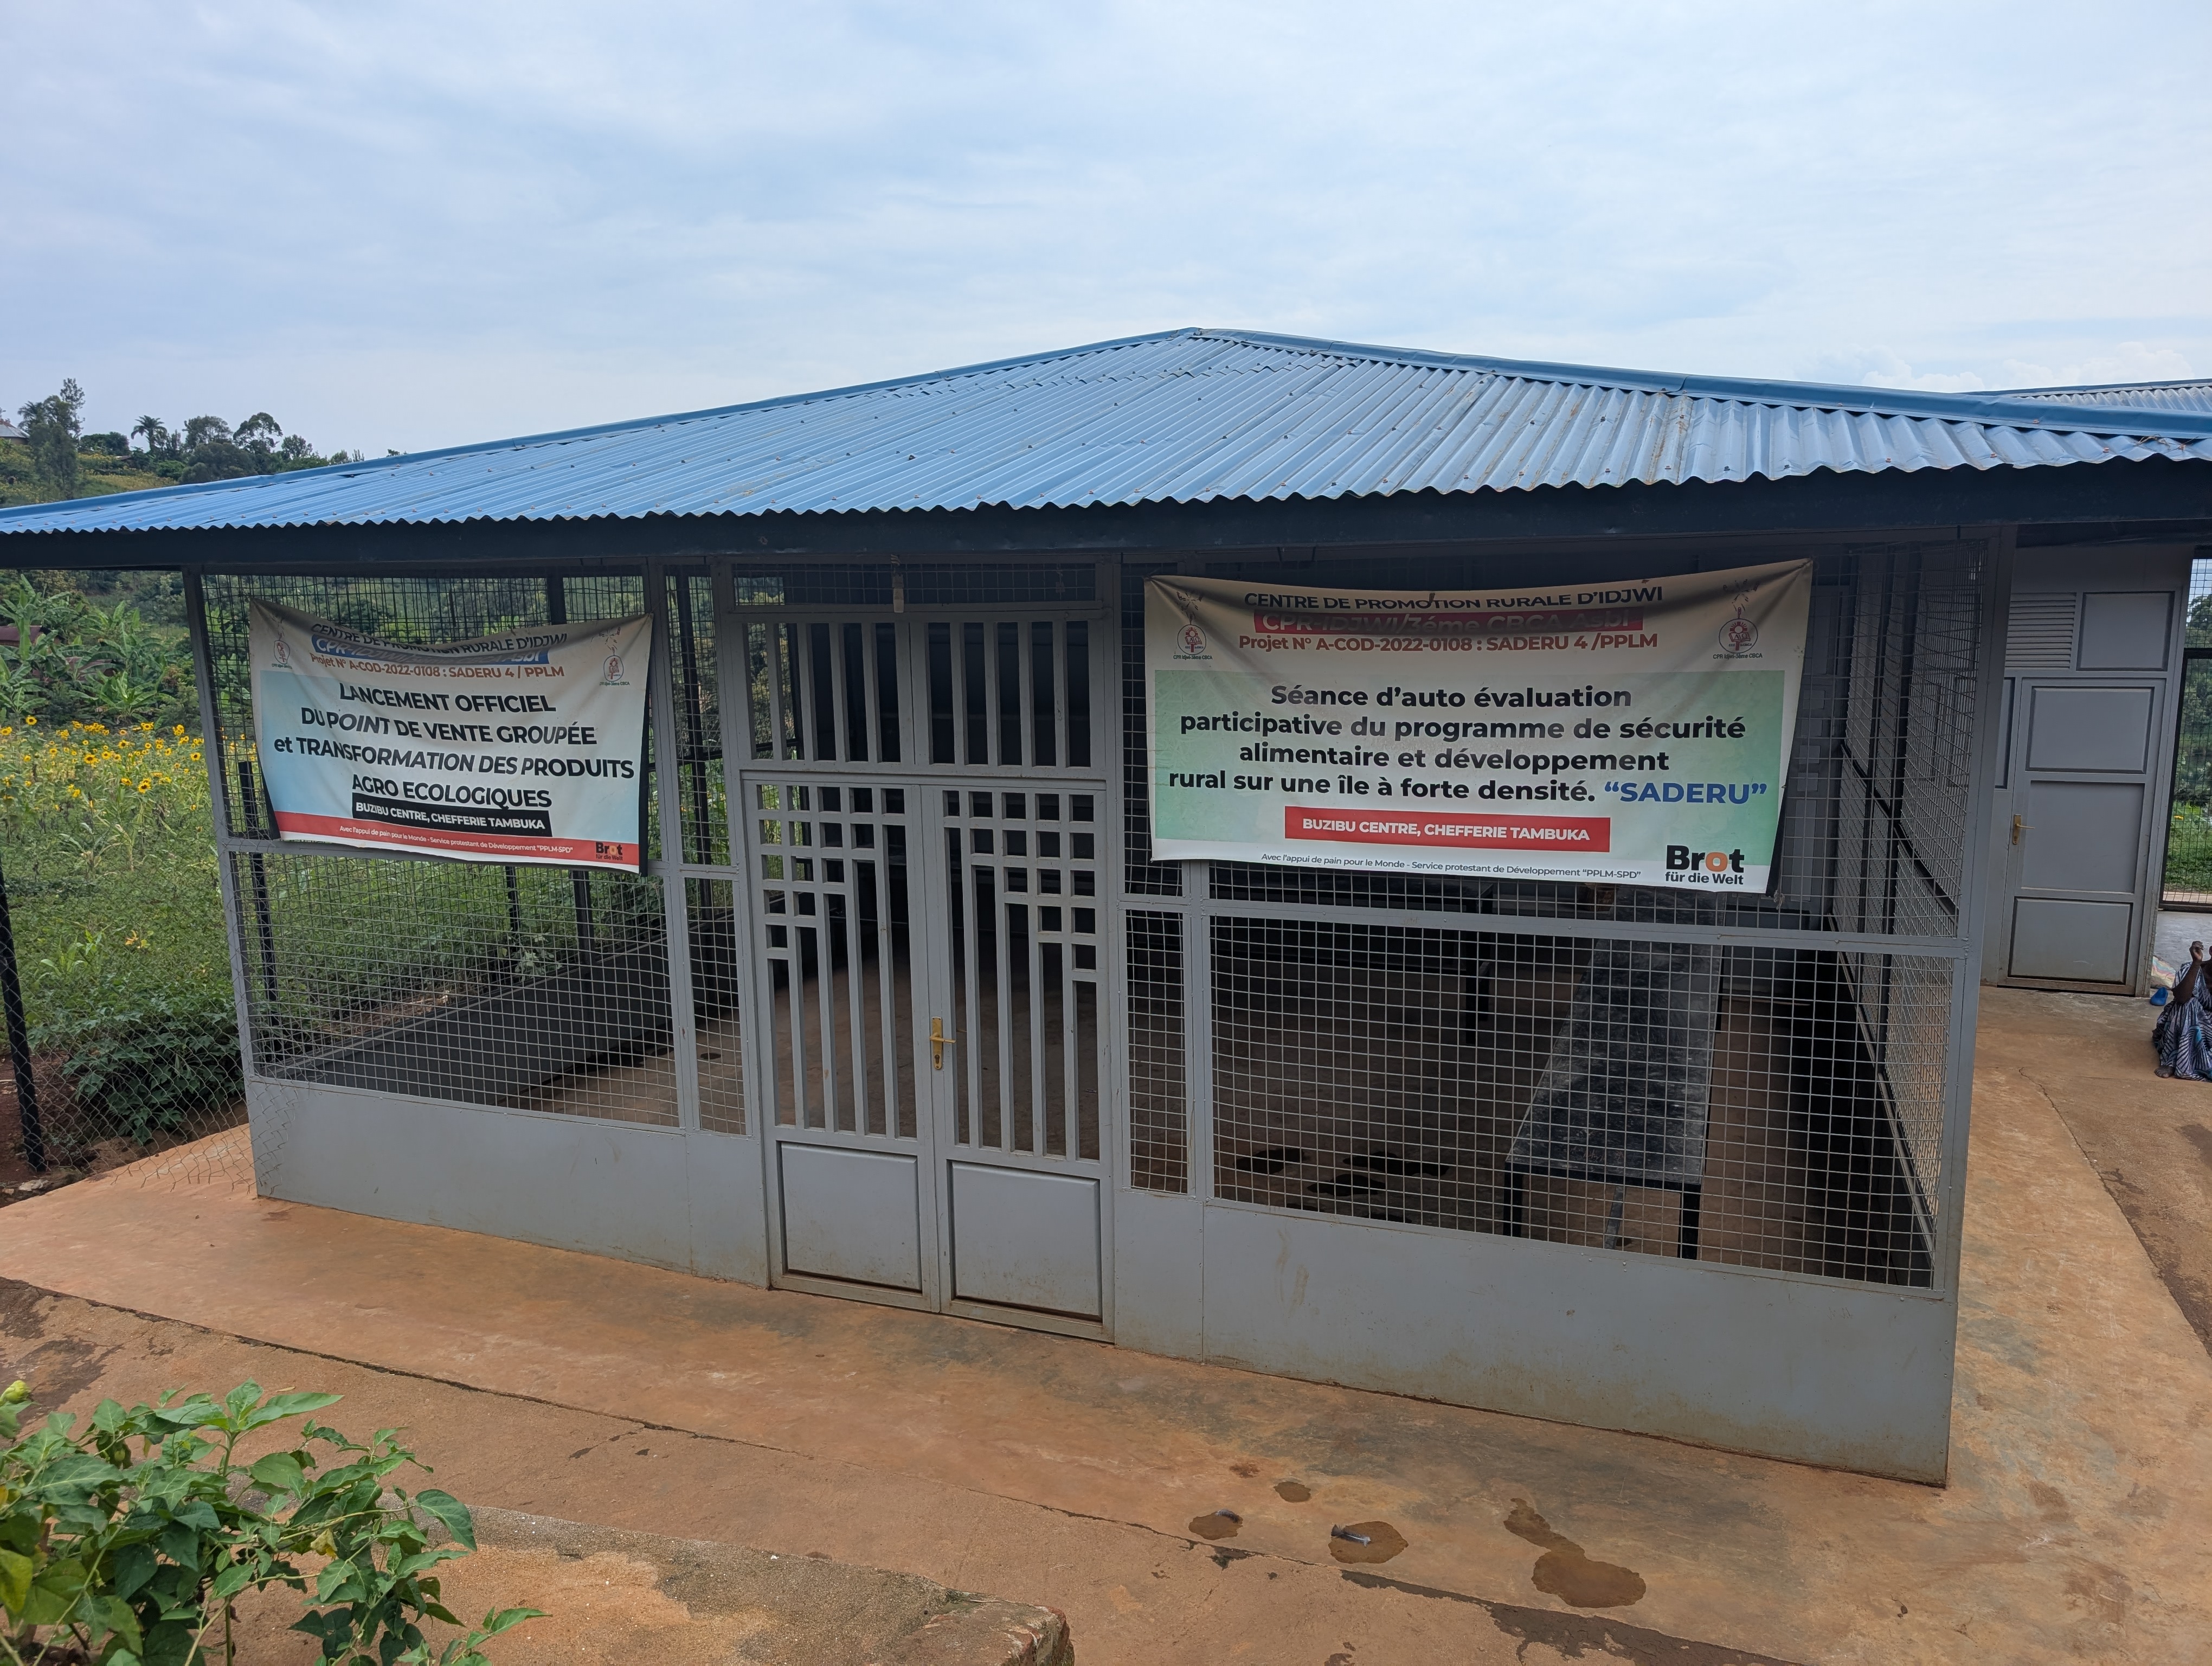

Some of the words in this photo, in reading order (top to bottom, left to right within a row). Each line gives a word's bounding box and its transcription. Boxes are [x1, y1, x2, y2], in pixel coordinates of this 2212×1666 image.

[1245, 593, 1319, 608] CENTRE
[1324, 598, 1351, 609] DE
[1355, 598, 1481, 610] PROMOTION
[1486, 594, 1572, 607] RURALE
[1578, 586, 1662, 605] D’IDJWI
[1487, 613, 1561, 632] CBCA
[1570, 610, 1629, 629] Asbl
[311, 624, 360, 644] CENTRE
[363, 636, 381, 646] DE
[461, 638, 514, 653] RURALE
[517, 633, 567, 649] D'IDJWI
[1239, 635, 1289, 652] Projet
[1316, 638, 1472, 651] A-COD-2022-0108
[1477, 640, 1482, 650] :
[1487, 636, 1569, 651] SADERU
[1574, 635, 1587, 649] 4
[309, 652, 335, 668] Projet
[350, 660, 440, 677] A-COD-2022-0108
[443, 669, 446, 677] :
[449, 667, 501, 678] SADERU
[505, 666, 515, 677] 4
[524, 666, 565, 677] PPLM
[339, 683, 449, 711] LANCEMENT
[455, 695, 556, 713] OFFICIEL
[1271, 685, 1368, 705] Séance
[1377, 687, 1465, 707] d’auto
[1474, 685, 1631, 707] évaluation
[301, 707, 325, 726] DU
[326, 712, 390, 734] POINT
[394, 719, 422, 738] DE
[423, 722, 493, 742] VENTE
[496, 721, 597, 745] GROUPÉE
[1181, 711, 1342, 736] participative
[1351, 716, 1385, 736] du
[1395, 720, 1564, 742] programme
[1574, 718, 1610, 739] de
[1619, 715, 1745, 739] sécurité
[274, 736, 293, 753] et
[296, 737, 475, 772] TRANSFORMATION
[478, 755, 518, 774] DES
[521, 758, 634, 779] PRODUITS
[1240, 741, 1389, 766] alimentaire
[1398, 750, 1426, 767] et
[1435, 748, 1669, 774] développement
[352, 774, 398, 797] AGRO
[403, 781, 552, 810] ECOLOGIQUES
[1169, 770, 1225, 789] rural
[1233, 776, 1273, 790] sur
[1281, 778, 1330, 793] une
[1338, 775, 1369, 794] île
[1378, 777, 1392, 796] à
[1400, 778, 1469, 798] forte
[1478, 780, 1595, 802] densité.
[1605, 781, 1767, 804] “SADERU”
[356, 802, 389, 816] BUZIBU
[390, 808, 430, 823] CENTRE,
[431, 813, 487, 826] CHEFFERIE
[488, 818, 545, 829] TAMBUKA
[353, 826, 370, 835] l'appui
[488, 842, 536, 851] Développement
[1303, 818, 1355, 832] BUZIBU
[1359, 822, 1420, 837] CENTRE,
[1424, 824, 1507, 838] CHEFFERIE
[1510, 827, 1590, 840] TAMBUKA
[596, 842, 622, 855] Brot
[1667, 845, 1744, 873] Brot
[1283, 855, 1310, 863] l'appui
[1375, 860, 1405, 868] Monde
[1412, 862, 1443, 870] Service
[1445, 864, 1491, 873] protestant
[1507, 866, 1580, 876] Développement
[1583, 869, 1641, 879] “PPLM-SPD”
[1666, 872, 1685, 882] für
[1688, 872, 1709, 883] die
[1712, 874, 1744, 885] Welt
